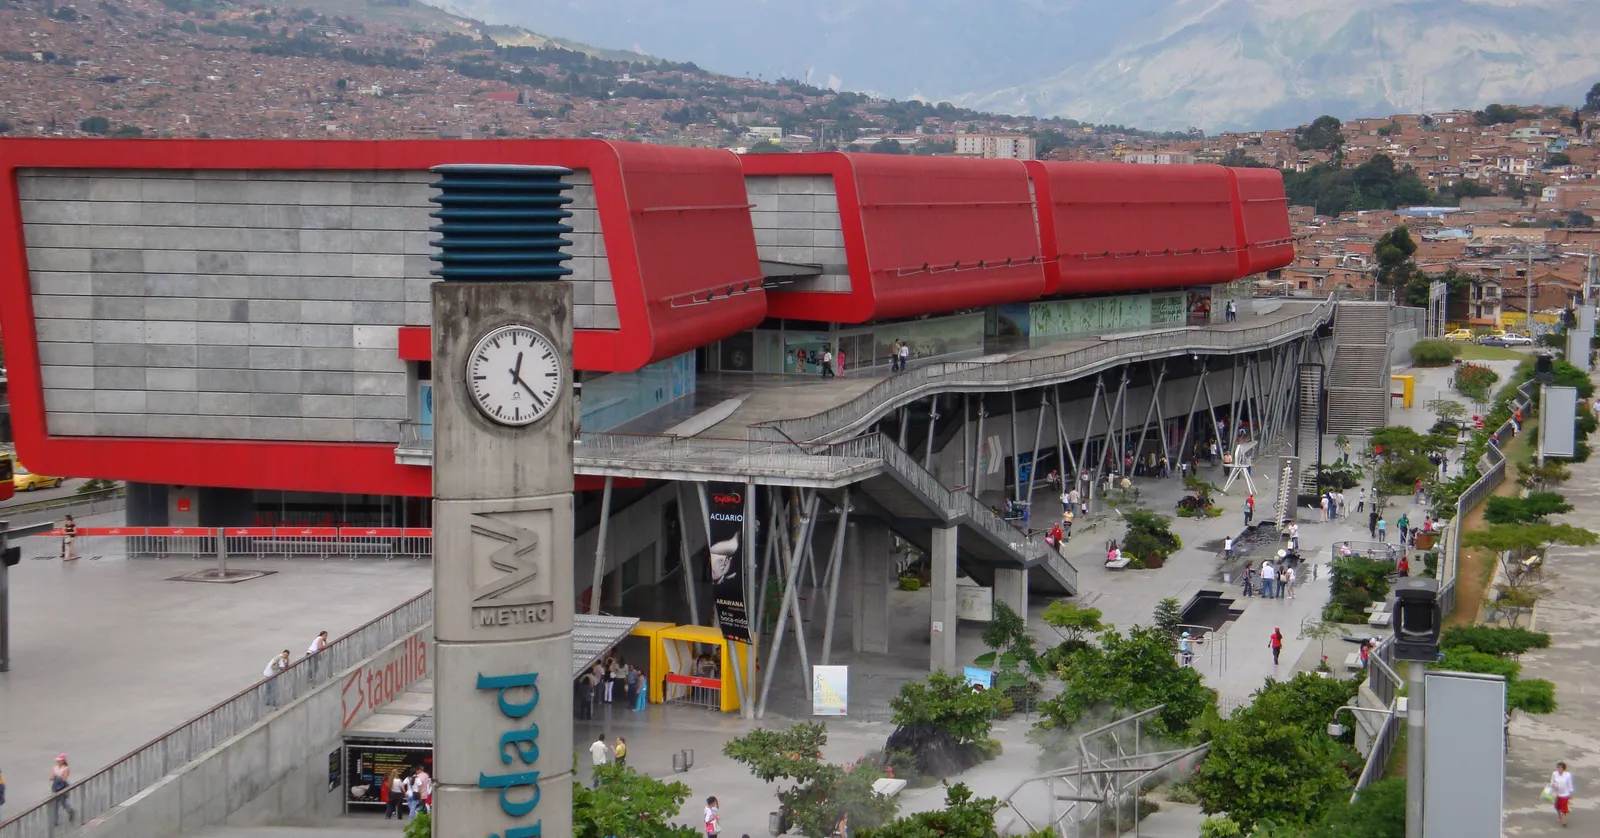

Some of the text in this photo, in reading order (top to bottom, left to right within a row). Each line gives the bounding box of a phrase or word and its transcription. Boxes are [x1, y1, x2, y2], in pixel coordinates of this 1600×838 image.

[710, 513, 743, 522] ACUARIO
[716, 598, 744, 608] ARAWANA
[480, 608, 548, 626] METRO
[366, 633, 427, 710] taquilla
